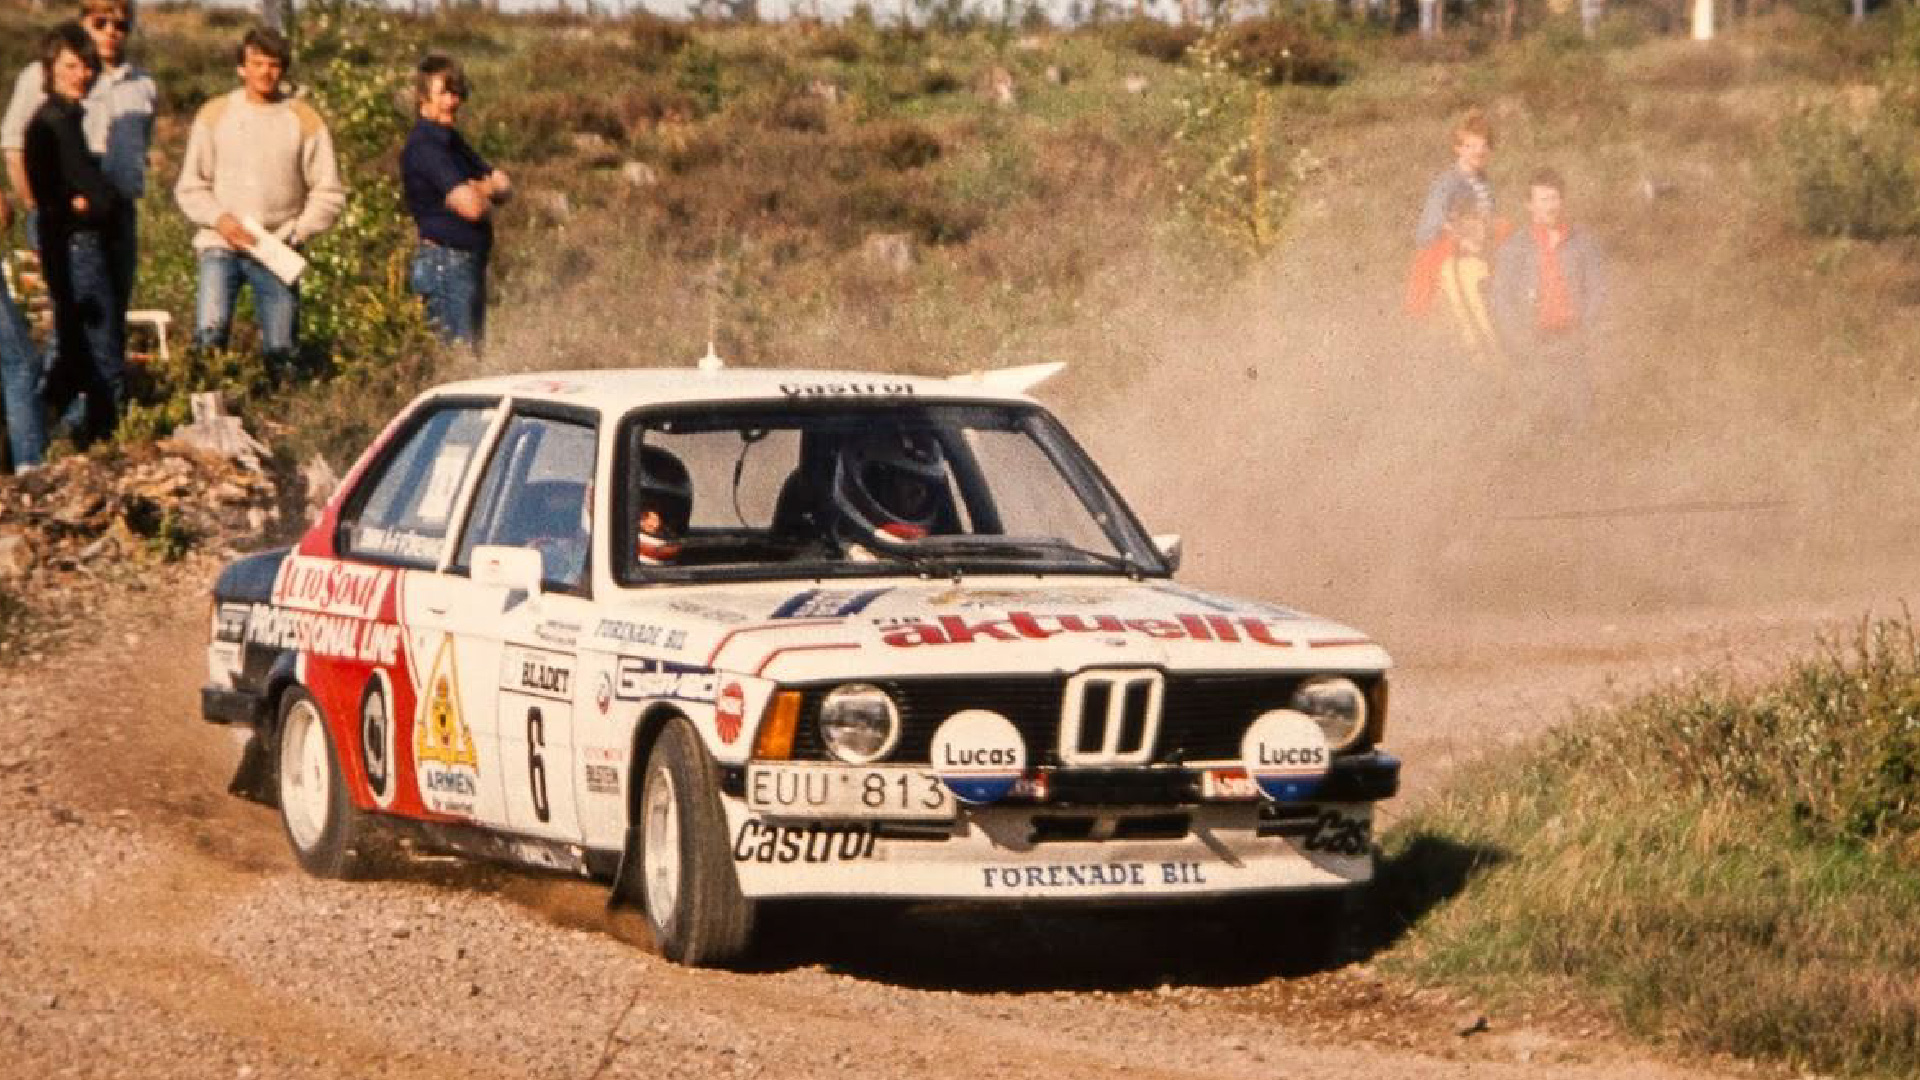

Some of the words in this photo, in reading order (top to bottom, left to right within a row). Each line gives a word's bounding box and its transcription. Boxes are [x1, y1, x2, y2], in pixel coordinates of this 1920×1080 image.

[359, 620, 401, 665] LINE
[879, 611, 1293, 648] aktuellt
[522, 662, 569, 692] BLADET
[527, 706, 550, 822] 6
[945, 743, 1016, 766] Lucas
[1259, 742, 1323, 765] Lucas
[754, 770, 830, 805] EUU
[861, 773, 945, 809] 813
[734, 818, 877, 863] Castrol
[1160, 862, 1207, 884] BIL
